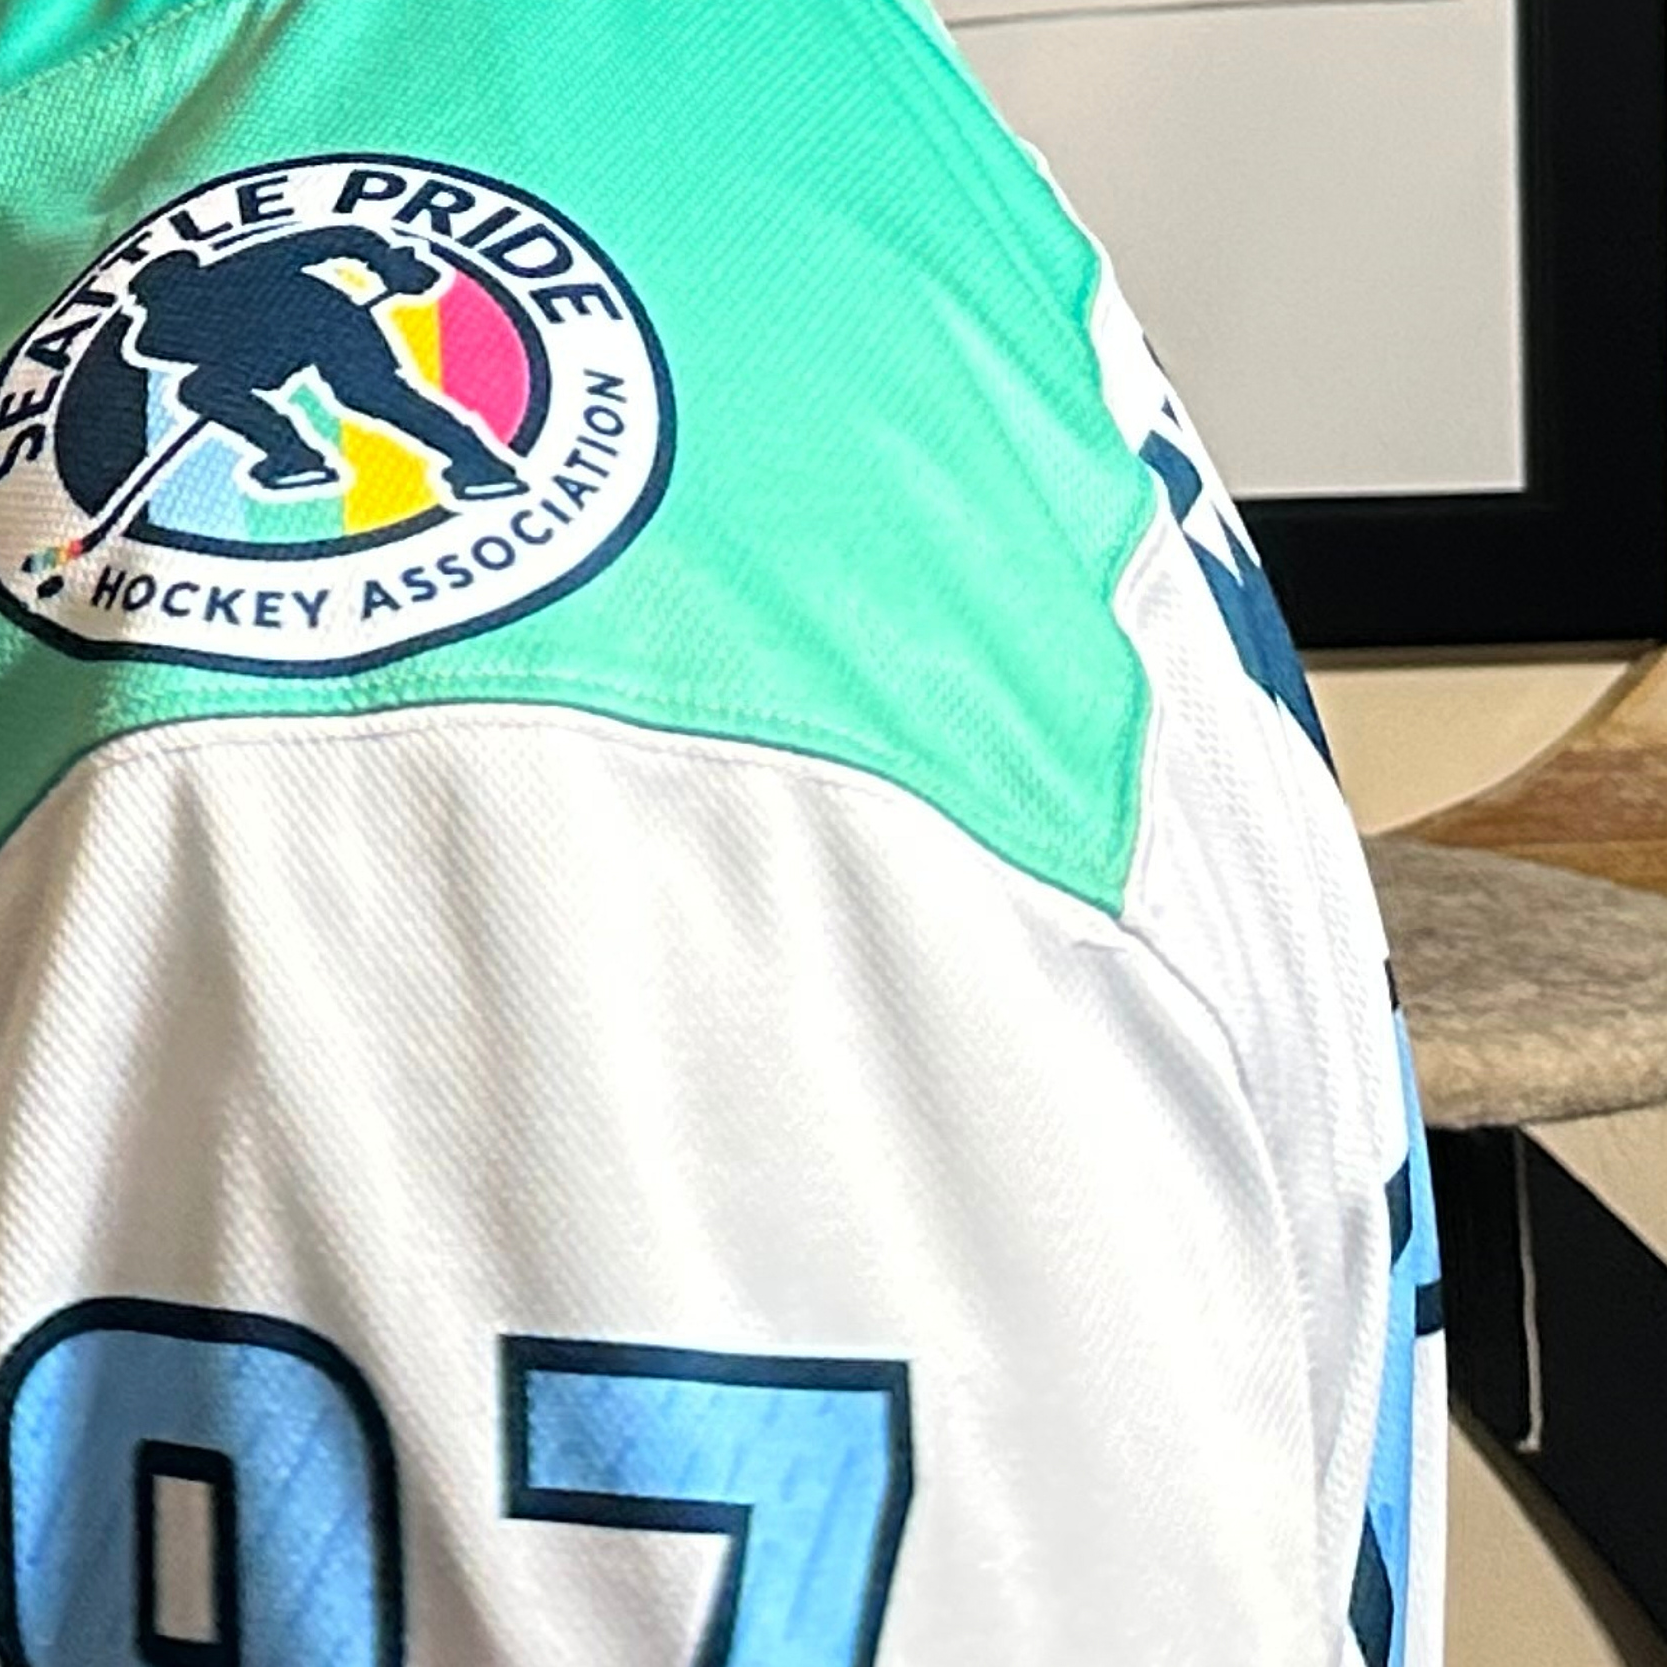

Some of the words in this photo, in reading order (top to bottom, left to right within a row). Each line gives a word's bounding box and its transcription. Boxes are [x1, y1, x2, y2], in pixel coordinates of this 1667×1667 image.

[333, 167, 624, 328] PRIDE
[90, 568, 332, 630] HOCKEY
[359, 367, 628, 624] ASSOCIATION
